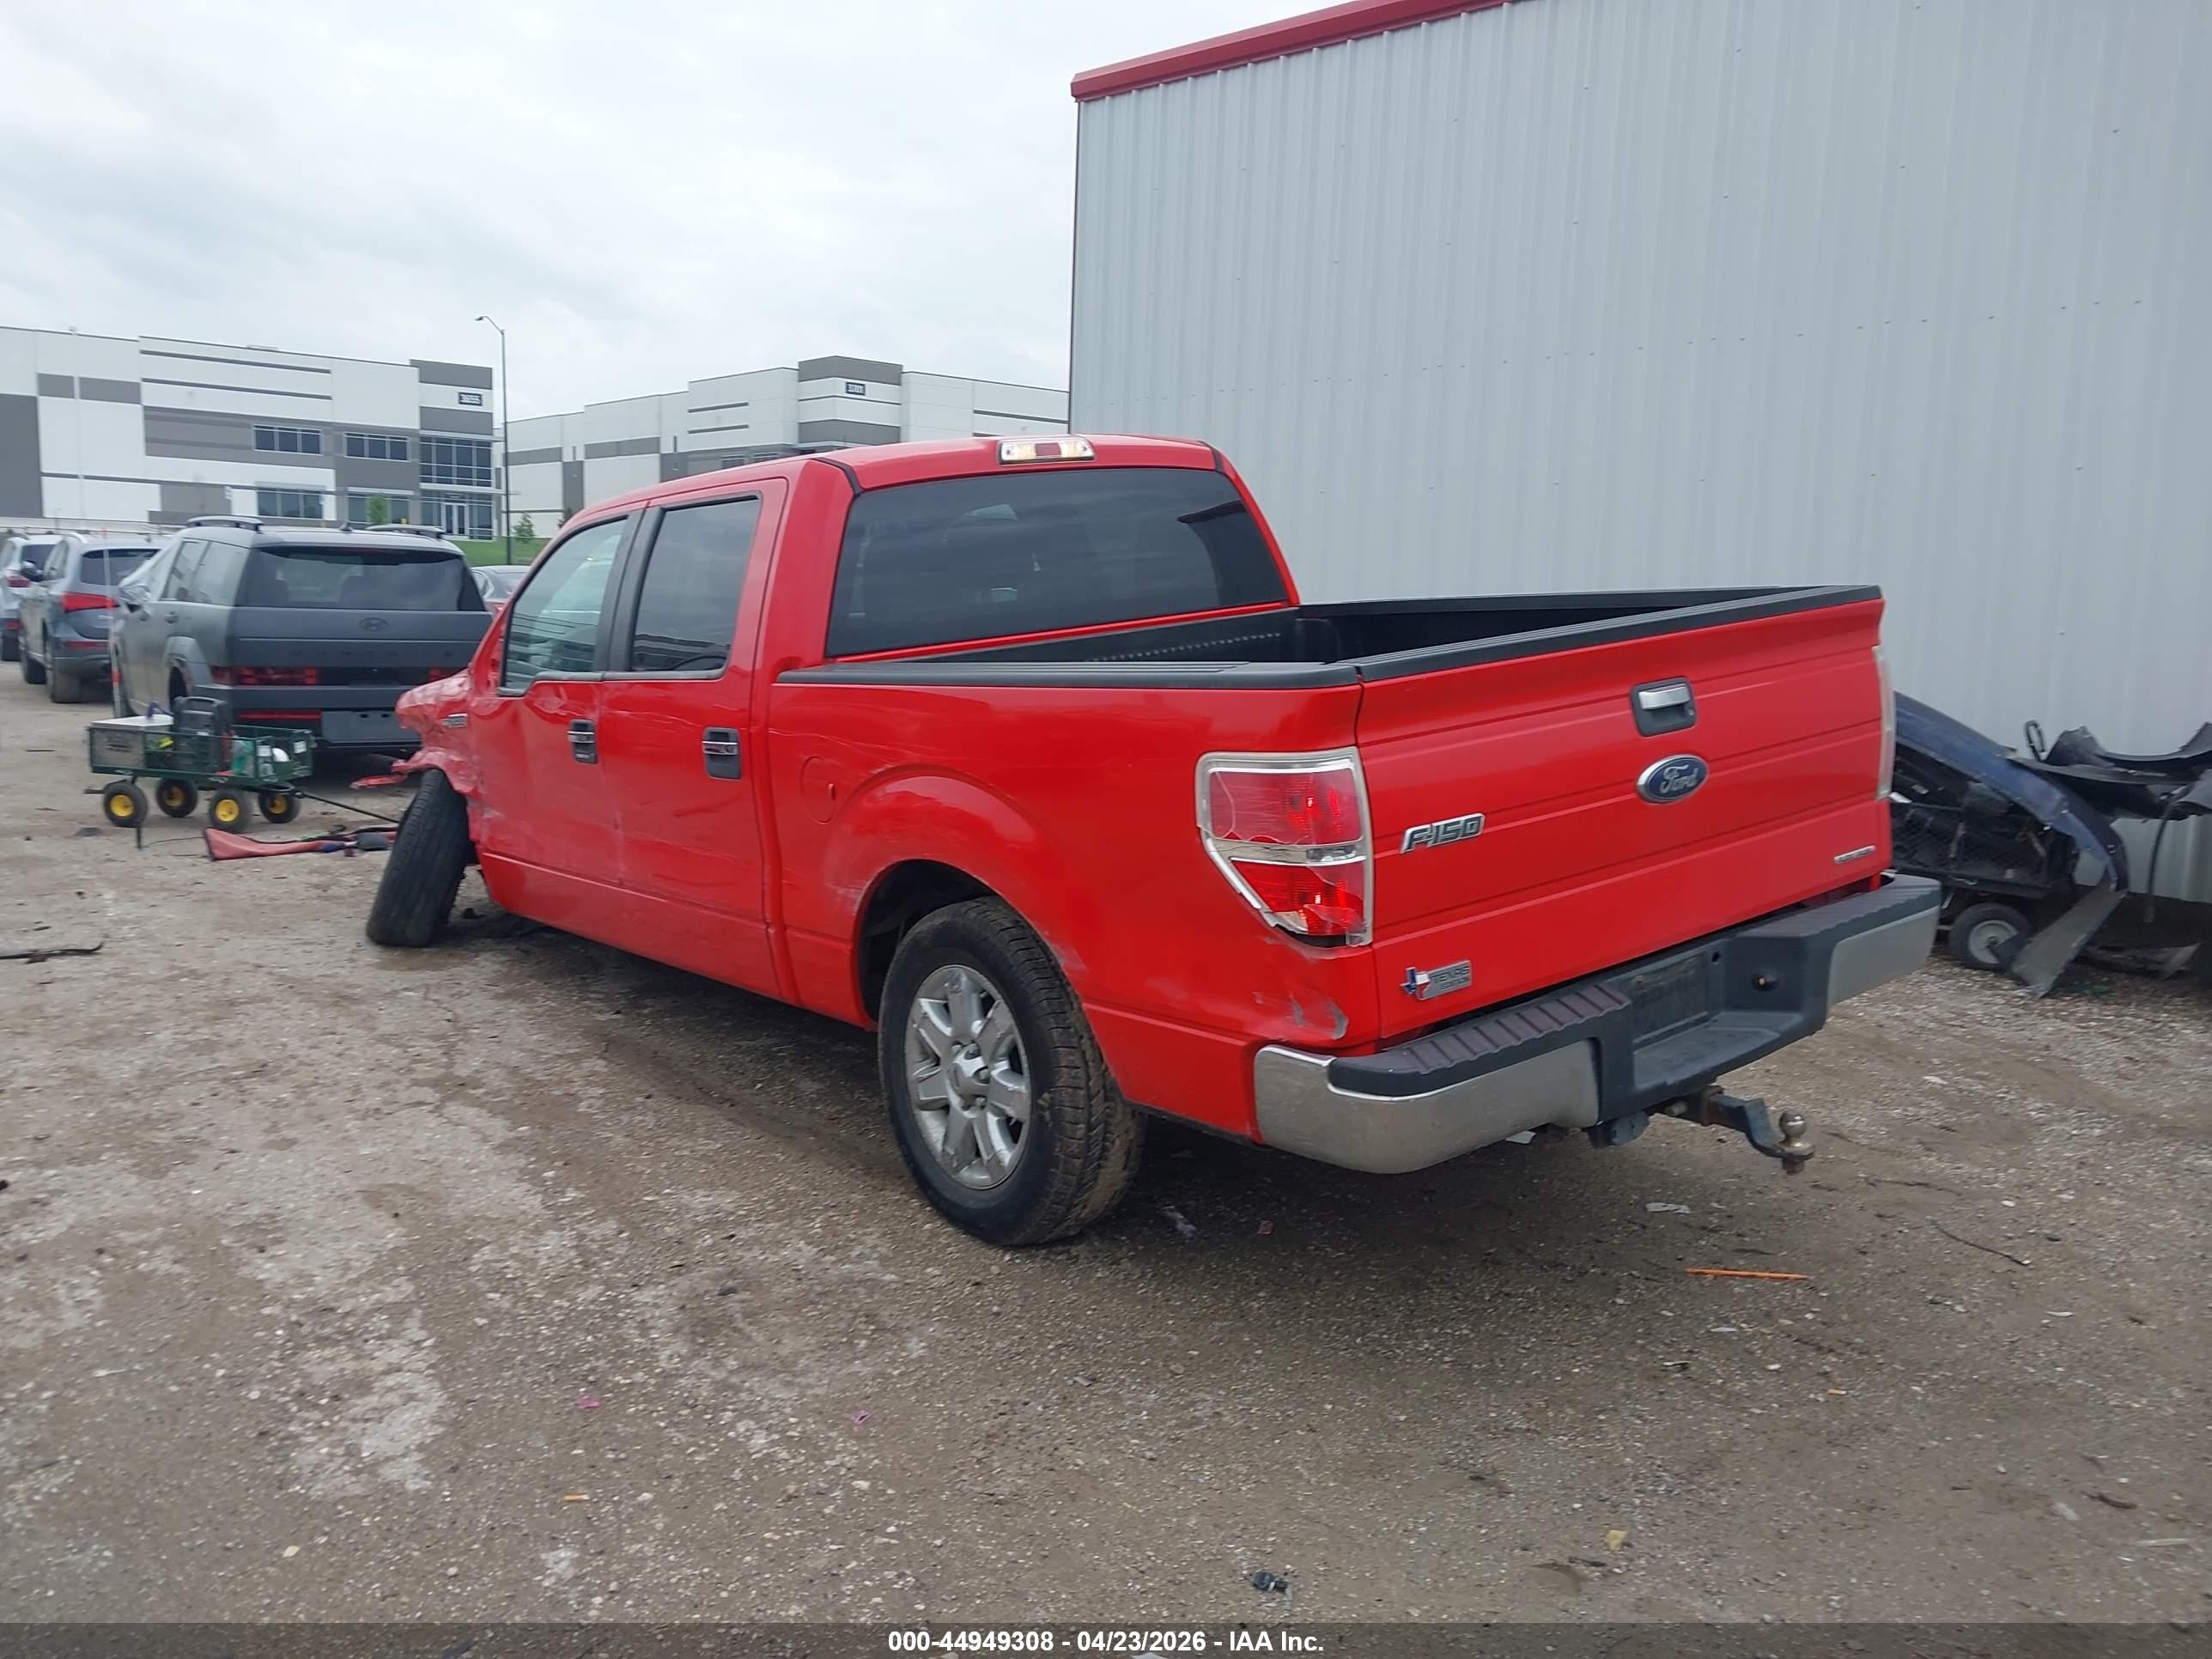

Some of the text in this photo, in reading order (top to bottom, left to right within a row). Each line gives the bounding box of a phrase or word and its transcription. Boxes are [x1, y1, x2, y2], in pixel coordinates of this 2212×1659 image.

[1659, 763, 1699, 794] Ford
[1400, 812, 1485, 854] F-150
[1430, 964, 1470, 984] TEXAS
